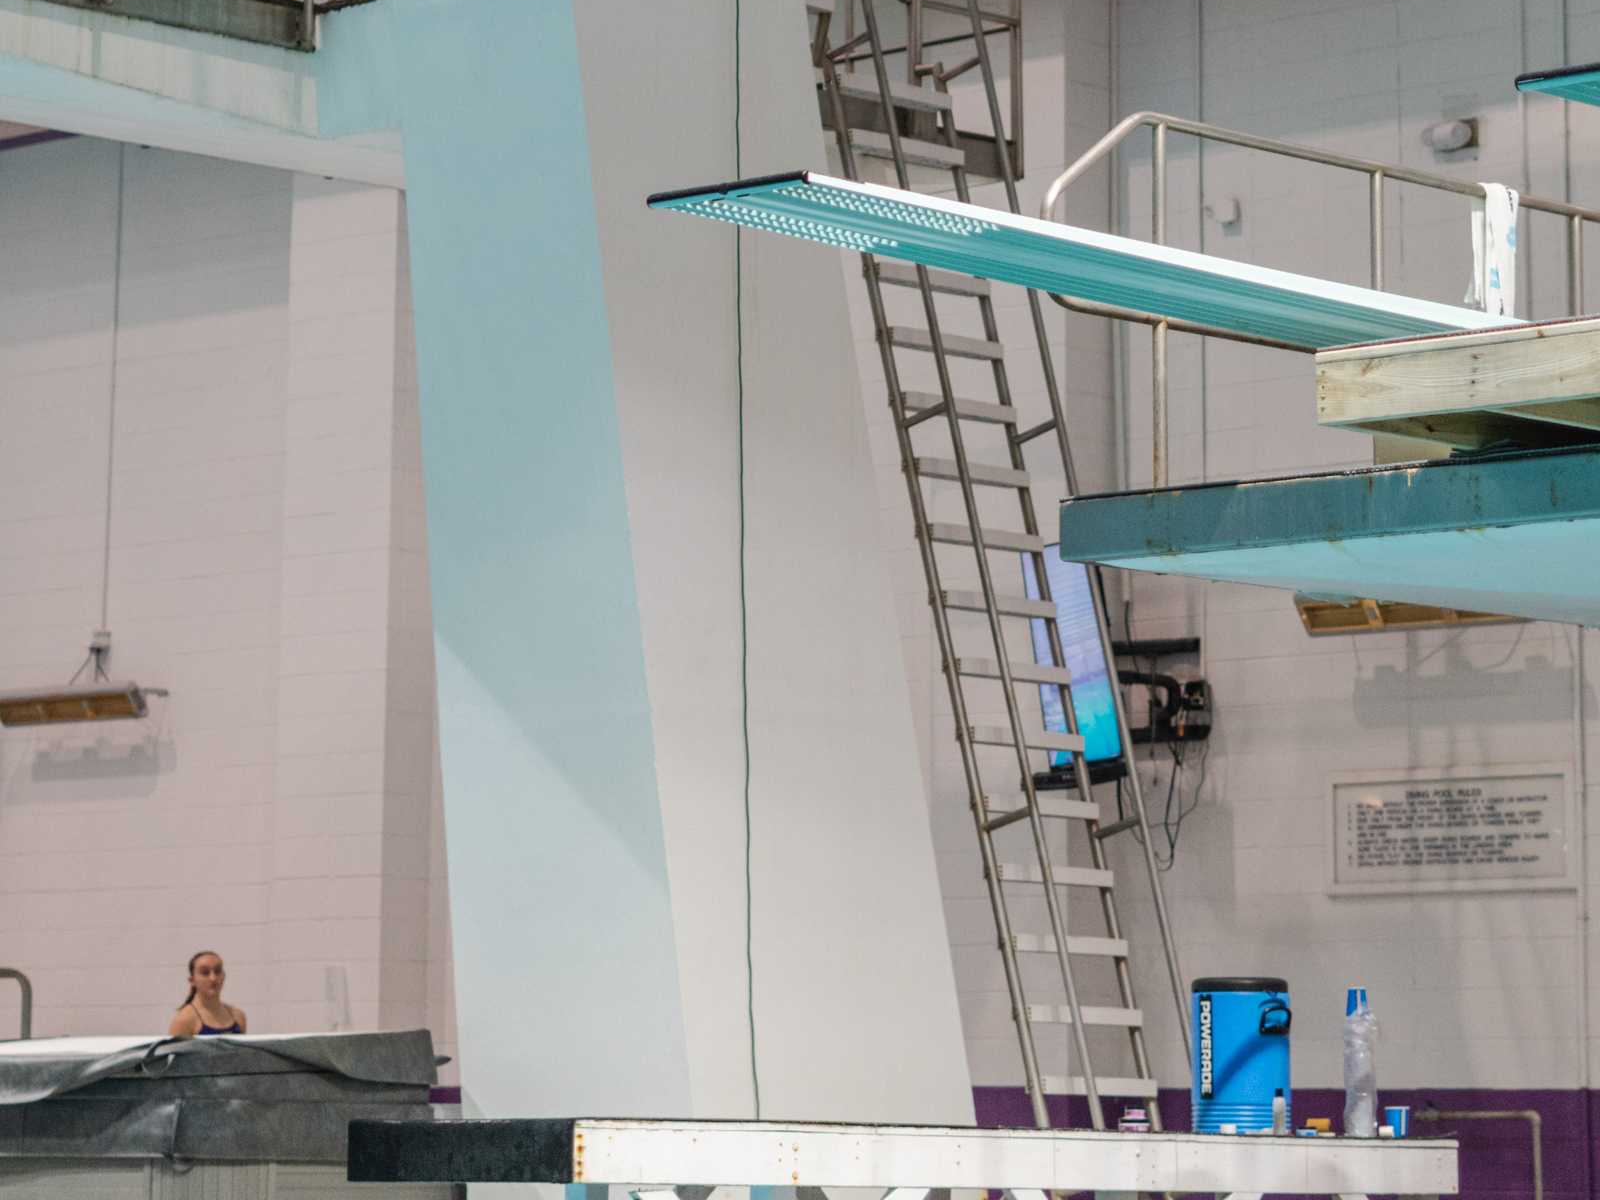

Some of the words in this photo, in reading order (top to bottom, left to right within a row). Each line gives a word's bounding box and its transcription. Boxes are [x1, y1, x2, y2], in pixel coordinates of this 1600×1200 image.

[1406, 790, 1430, 799] DIVING
[1433, 789, 1454, 798] POOL
[1457, 788, 1482, 797] RULES
[1200, 1000, 1212, 1094] POWERADE
